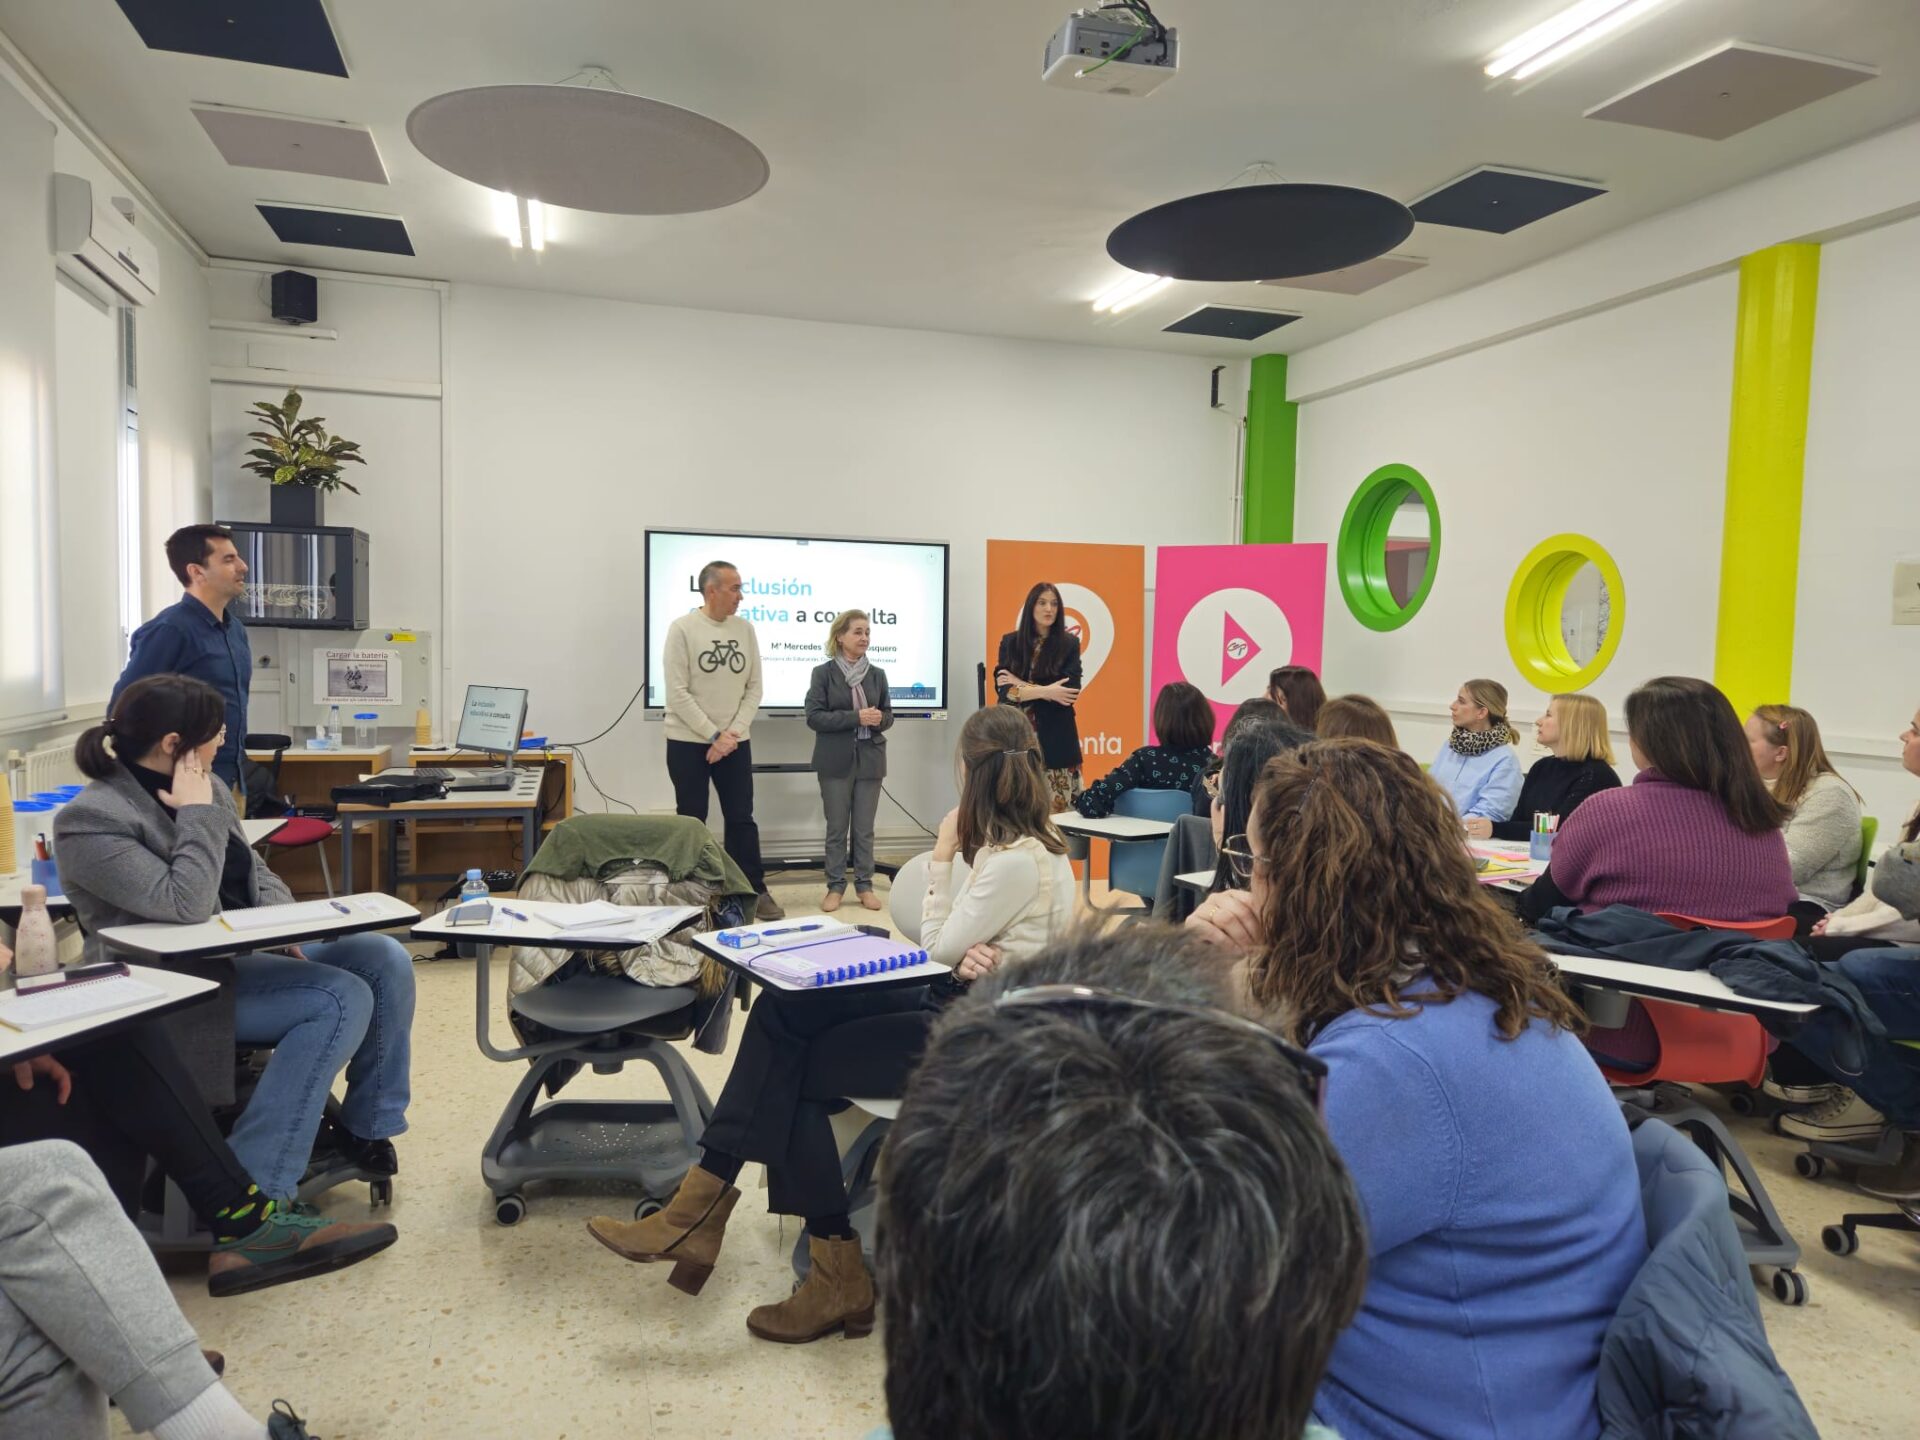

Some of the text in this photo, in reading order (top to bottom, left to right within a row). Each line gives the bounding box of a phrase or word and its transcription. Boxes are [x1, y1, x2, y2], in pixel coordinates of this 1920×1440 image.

[741, 578, 812, 596] clusión
[796, 610, 807, 622] a
[814, 608, 897, 625] colta
[784, 642, 822, 651] Mercedes
[326, 651, 350, 659] Cargar
